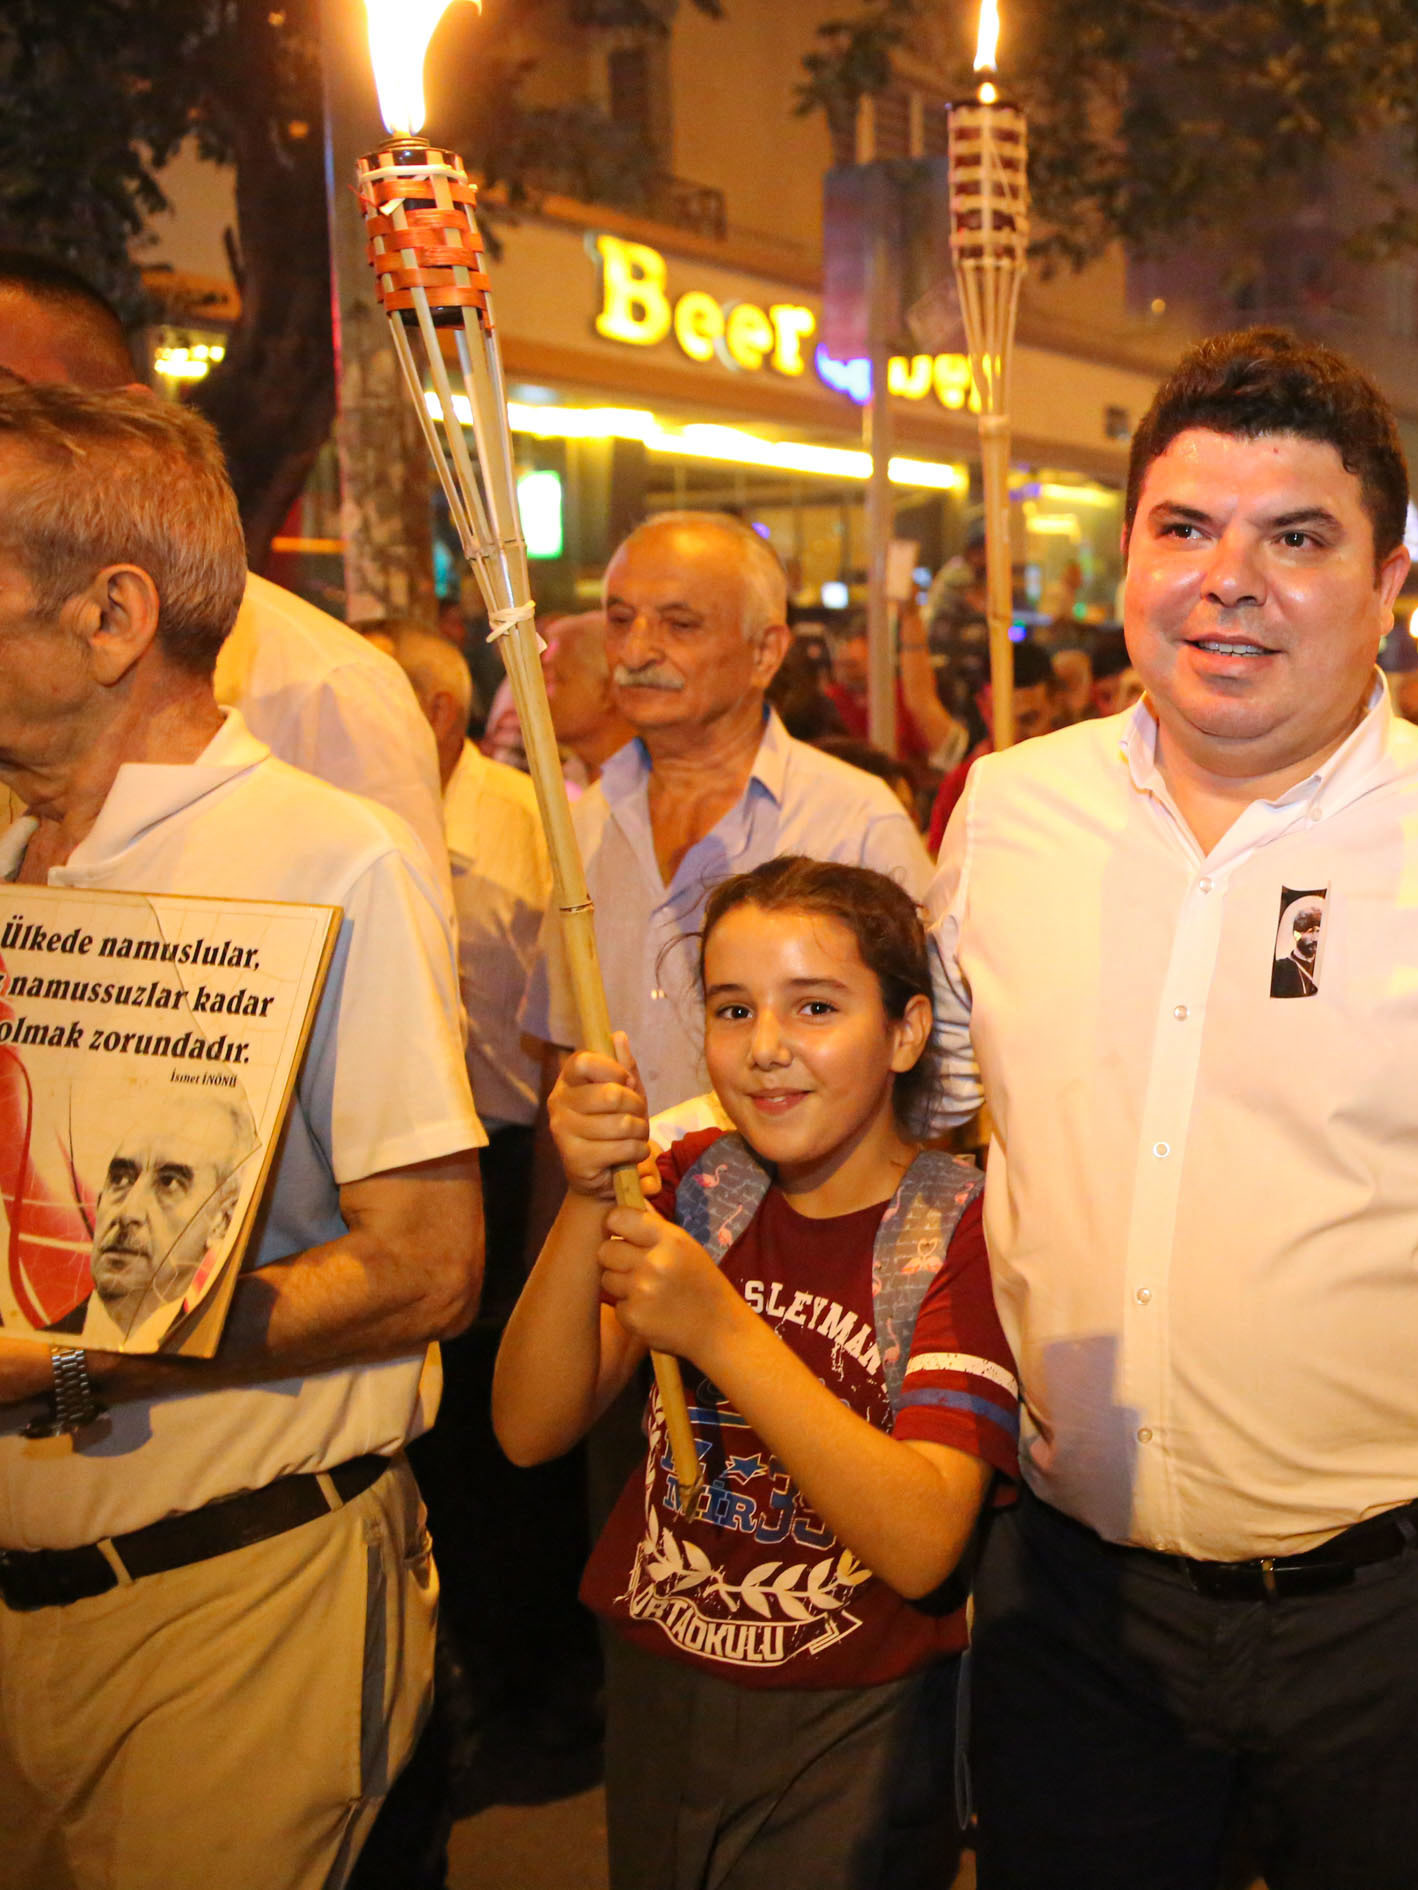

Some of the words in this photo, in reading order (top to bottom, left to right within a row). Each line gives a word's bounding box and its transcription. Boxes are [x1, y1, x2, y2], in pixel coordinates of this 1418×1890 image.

[595, 234, 816, 377] Beer
[0, 914, 94, 957] Ülkede
[98, 935, 261, 971] namuslular,
[8, 974, 189, 1012] namussuzlar
[192, 985, 275, 1018] kadar
[0, 1016, 84, 1050] olmak
[89, 1027, 250, 1064] zorundadır.
